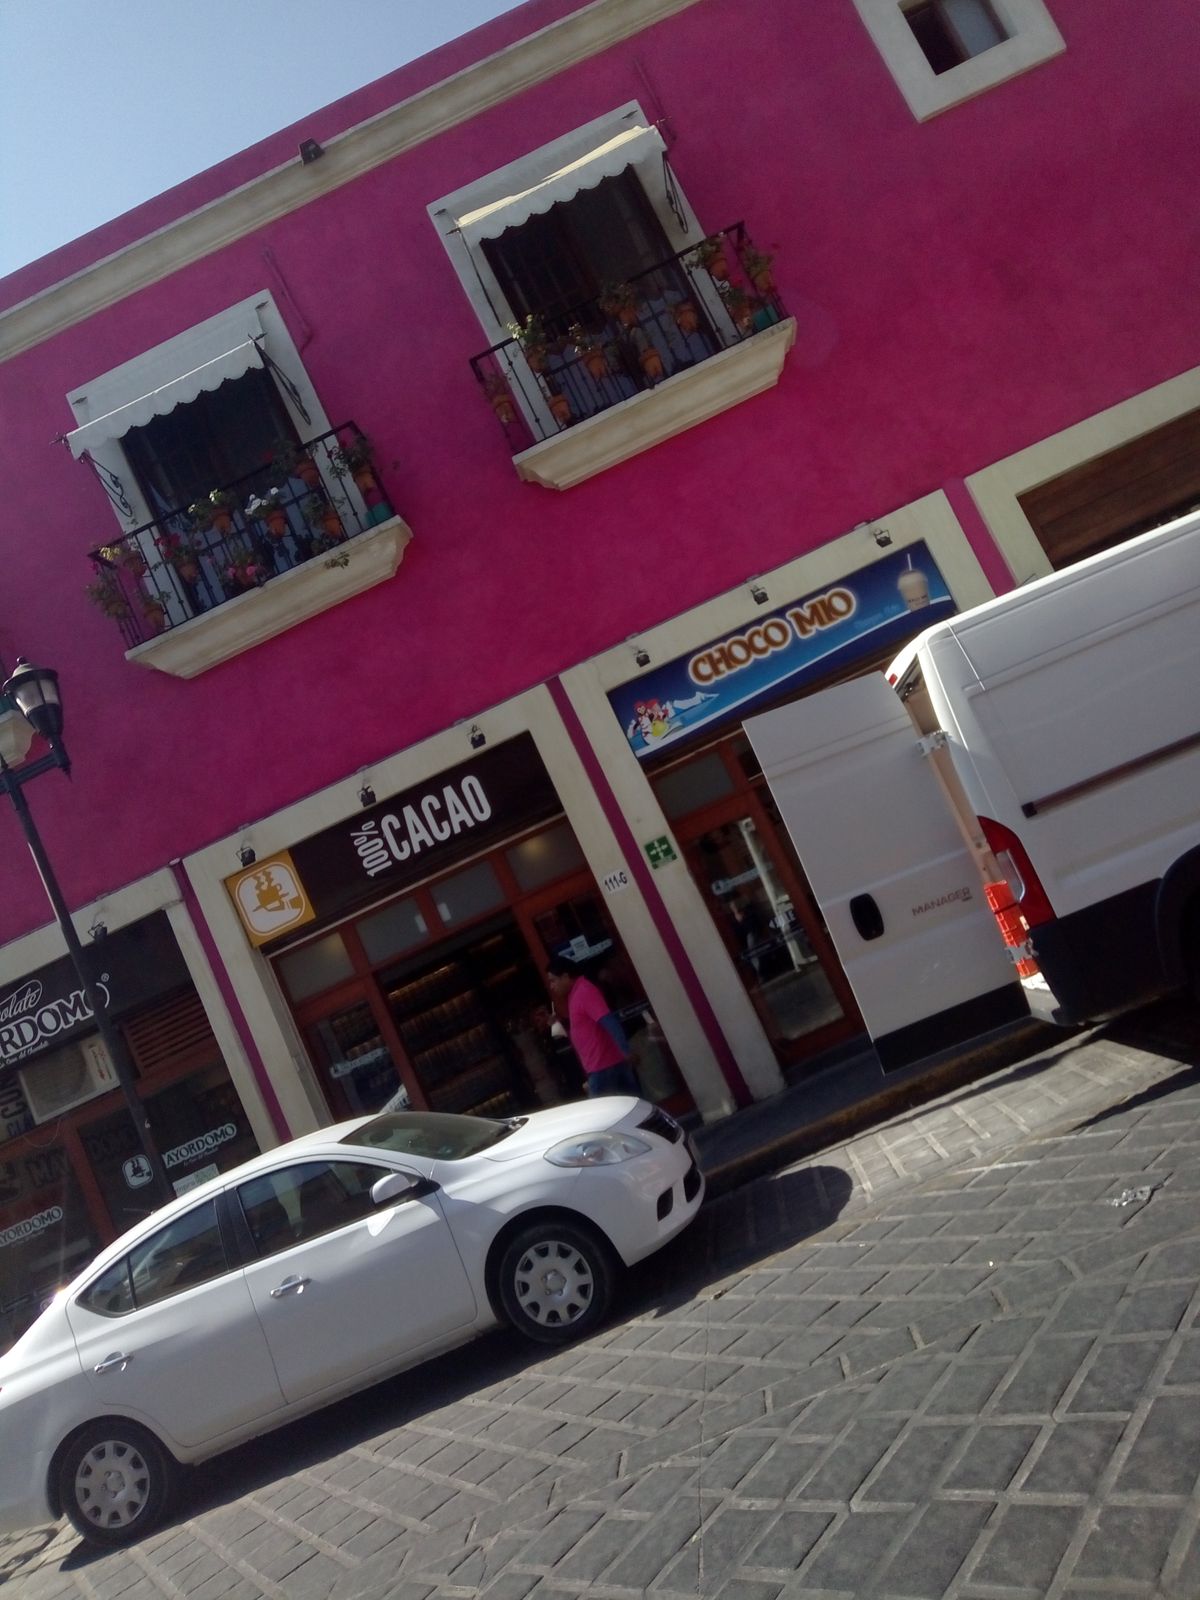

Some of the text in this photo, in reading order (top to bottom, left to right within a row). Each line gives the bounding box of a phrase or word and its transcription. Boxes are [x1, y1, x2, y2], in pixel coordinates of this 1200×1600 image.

[691, 620, 791, 683] CHOCO
[787, 590, 854, 637] MIO
[351, 775, 492, 876] 100% CACAO
[912, 887, 971, 916] MANAGER
